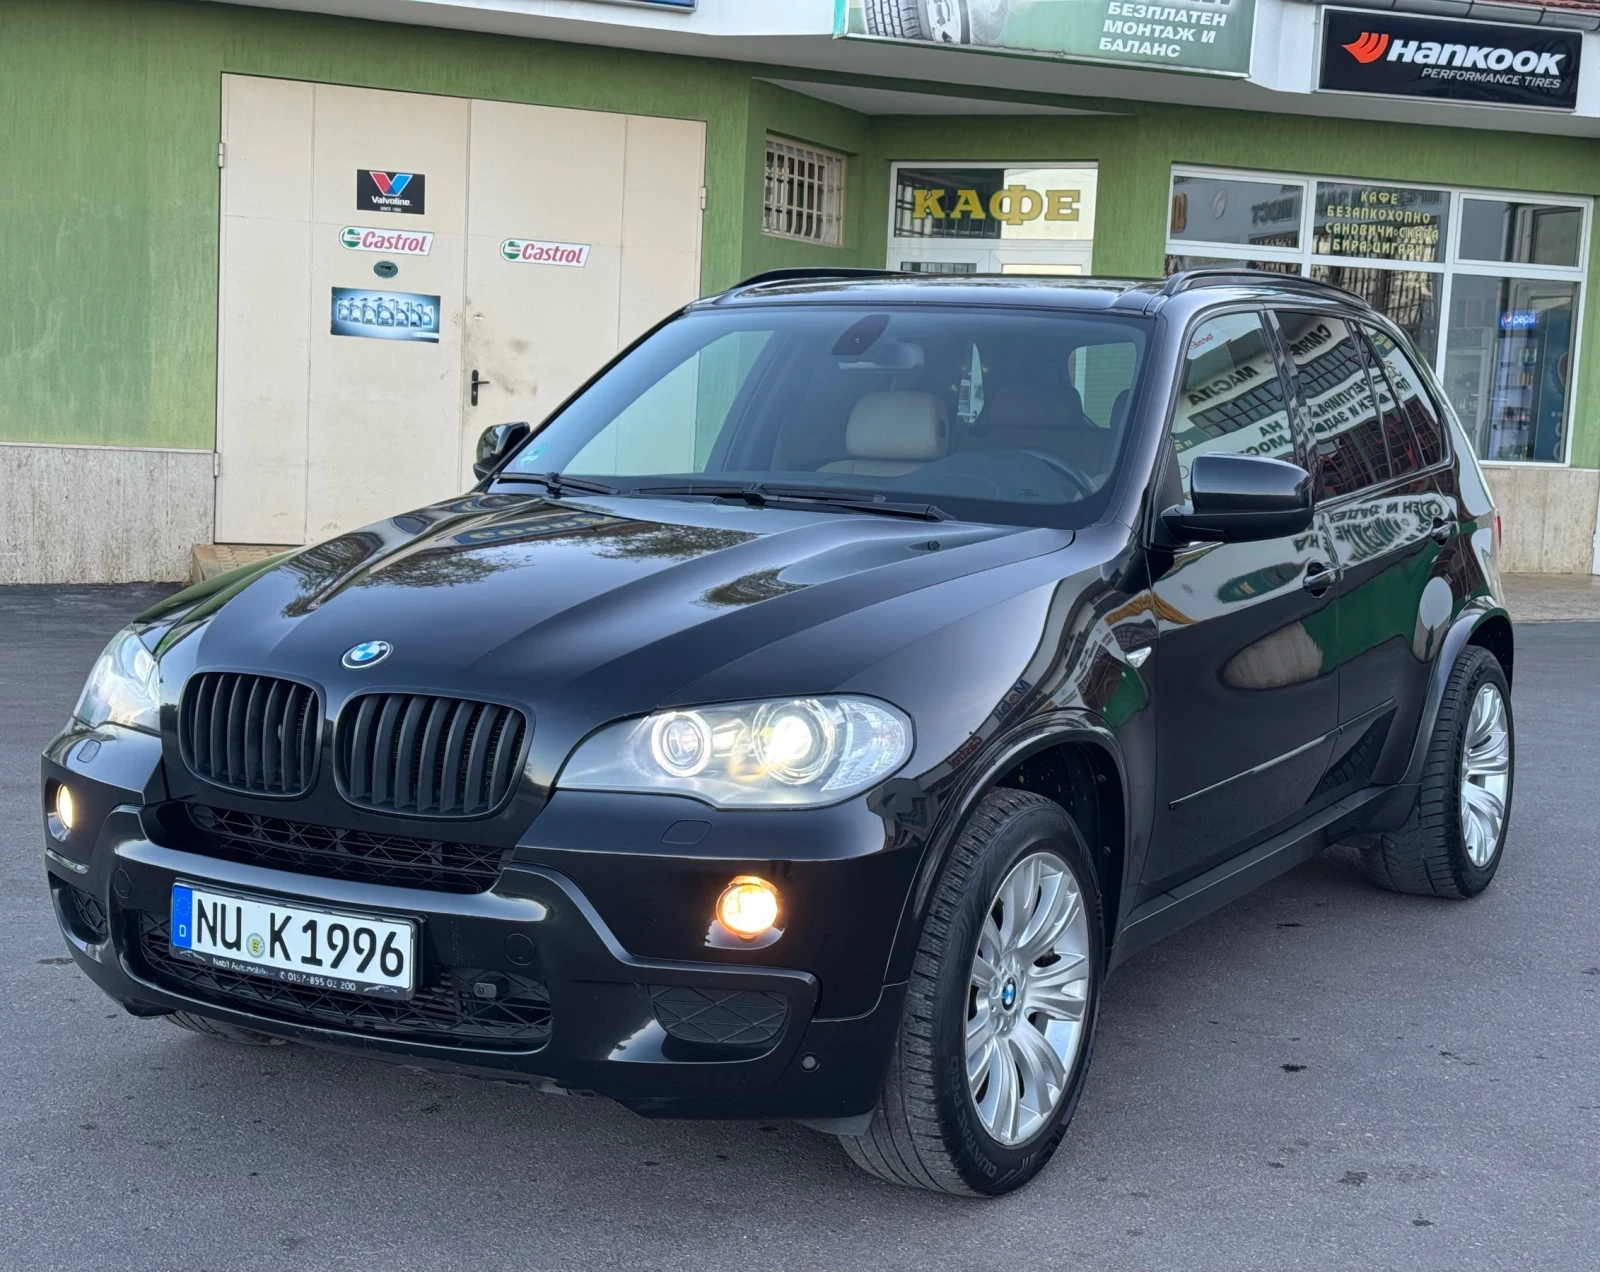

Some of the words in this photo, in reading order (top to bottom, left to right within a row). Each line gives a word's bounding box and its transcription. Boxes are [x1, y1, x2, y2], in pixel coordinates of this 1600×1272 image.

[1107, 1, 1228, 27] БЕЗПЛАТЕН
[1102, 19, 1197, 42] МОНТАЖ
[1200, 29, 1217, 44] И
[1098, 37, 1182, 58] БАЛАНС
[1420, 67, 1521, 86] PERFORMANCE
[1523, 75, 1562, 90] TIRES
[371, 195, 412, 207] Valvoline
[912, 184, 1081, 226] КАФЕ
[1360, 190, 1398, 205] КАФЕ
[362, 230, 427, 252] Castrol
[1332, 237, 1367, 254] БИРА
[1372, 239, 1424, 256] ЦИГАРИ
[522, 243, 584, 264] Castrol
[1513, 312, 1537, 327] pepsi
[178, 924, 188, 938] D
[196, 898, 243, 953] NU
[340, 981, 357, 992] 200
